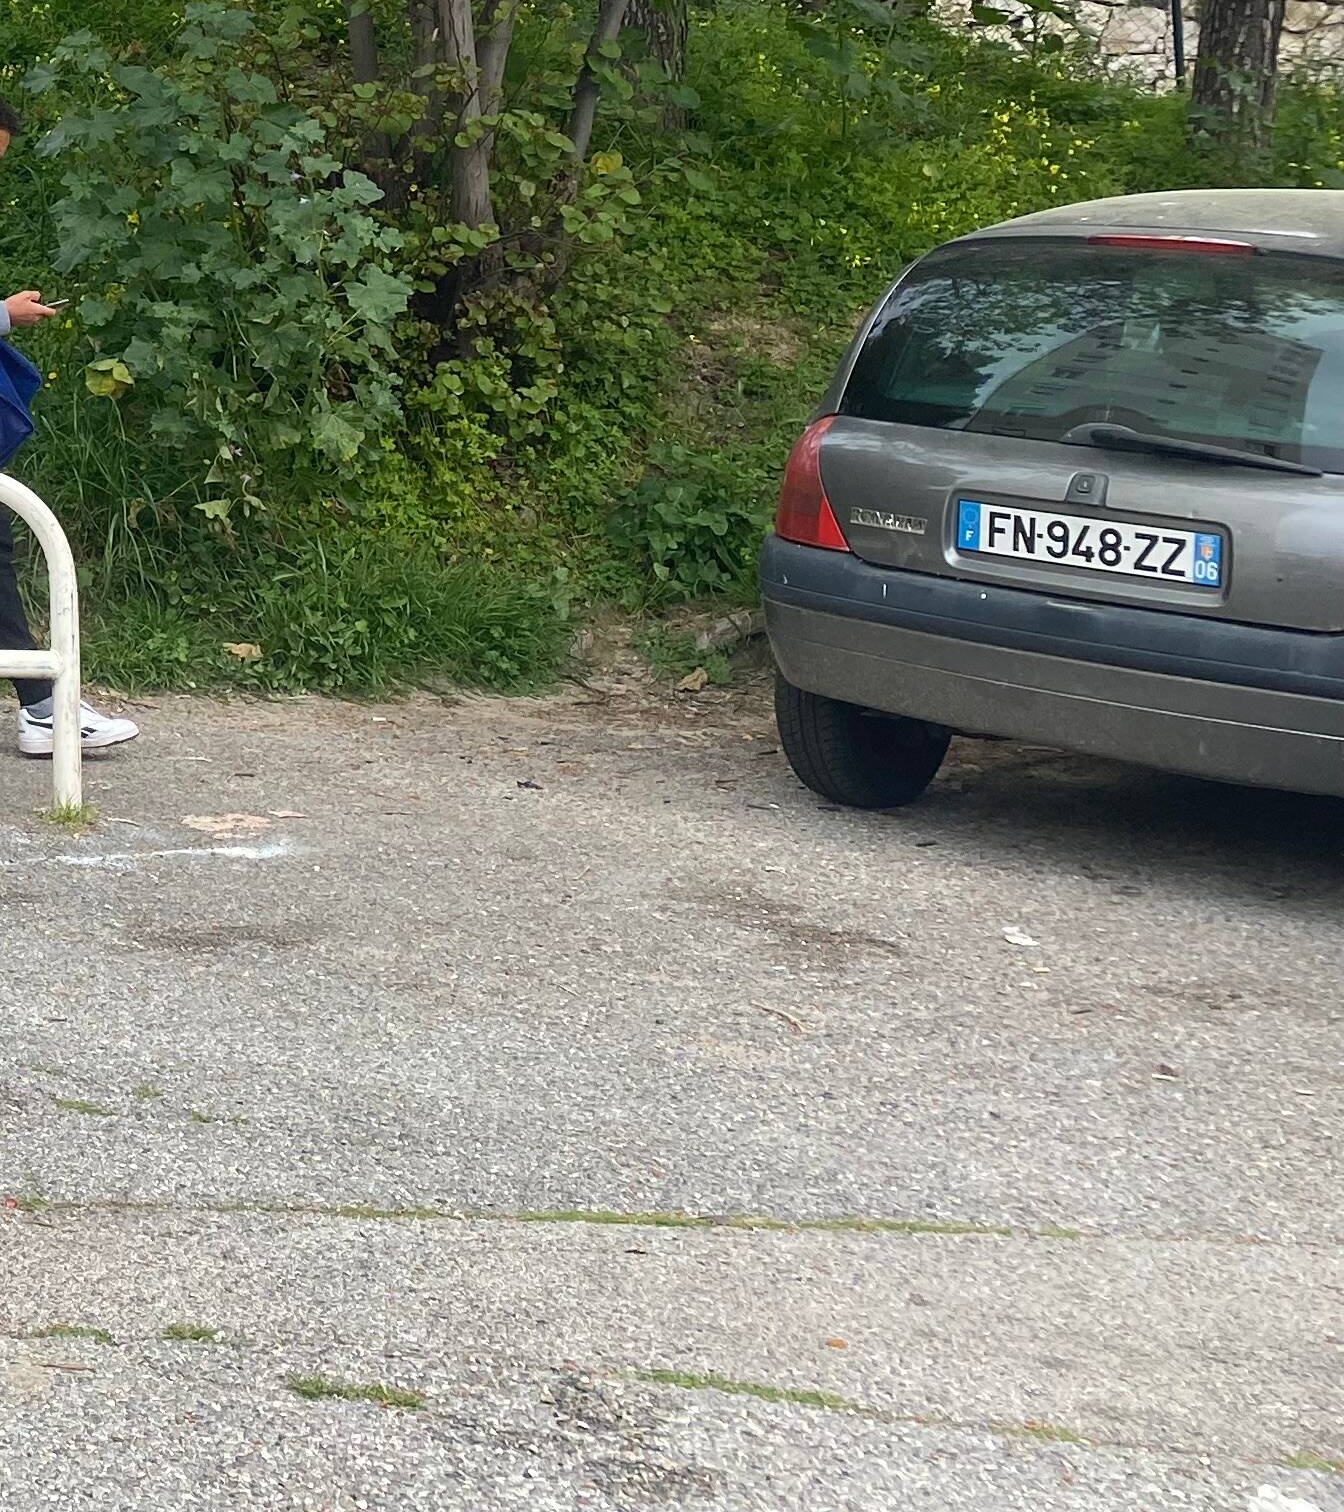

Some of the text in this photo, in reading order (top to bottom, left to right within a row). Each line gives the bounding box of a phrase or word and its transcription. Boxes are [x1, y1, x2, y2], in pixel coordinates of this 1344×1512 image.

[965, 529, 974, 541] F
[988, 511, 1187, 577] FN-948-ZZ
[1195, 559, 1218, 581] 06
